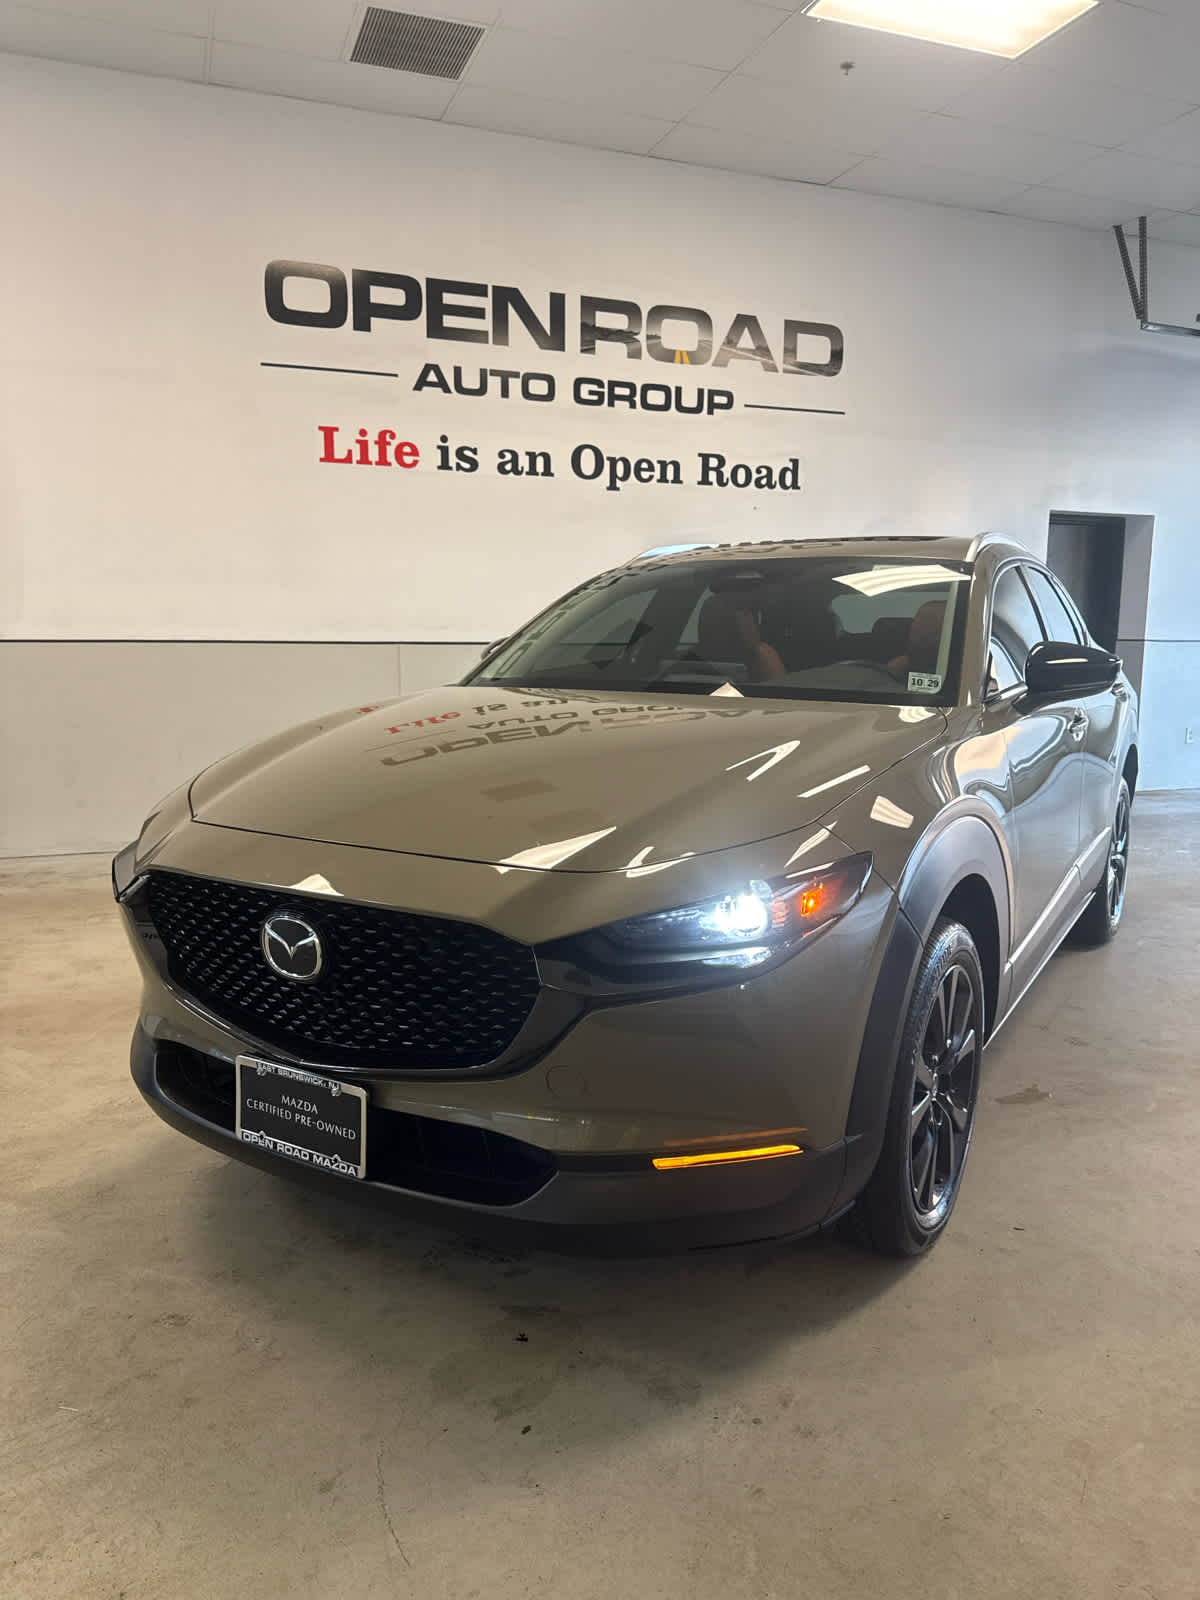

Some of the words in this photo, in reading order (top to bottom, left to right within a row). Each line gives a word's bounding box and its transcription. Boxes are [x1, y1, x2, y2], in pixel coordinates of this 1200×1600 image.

[265, 259, 566, 353] OPEN
[579, 295, 845, 377] ROAD
[412, 363, 556, 403] AUTO
[572, 377, 735, 416] GROUP
[318, 426, 420, 469] Life
[437, 435, 479, 474] is
[496, 448, 555, 478] an
[570, 443, 684, 491] Open
[697, 453, 801, 491] Road
[911, 678, 923, 687] 10
[246, 1098, 292, 1121] CERTIFIED
[294, 1113, 356, 1141] PRE-OWNED
[280, 1095, 318, 1115] MAZDA
[242, 1132, 274, 1150] OPEN
[276, 1144, 310, 1161] ROAD
[312, 1154, 357, 1177] MAZDA
